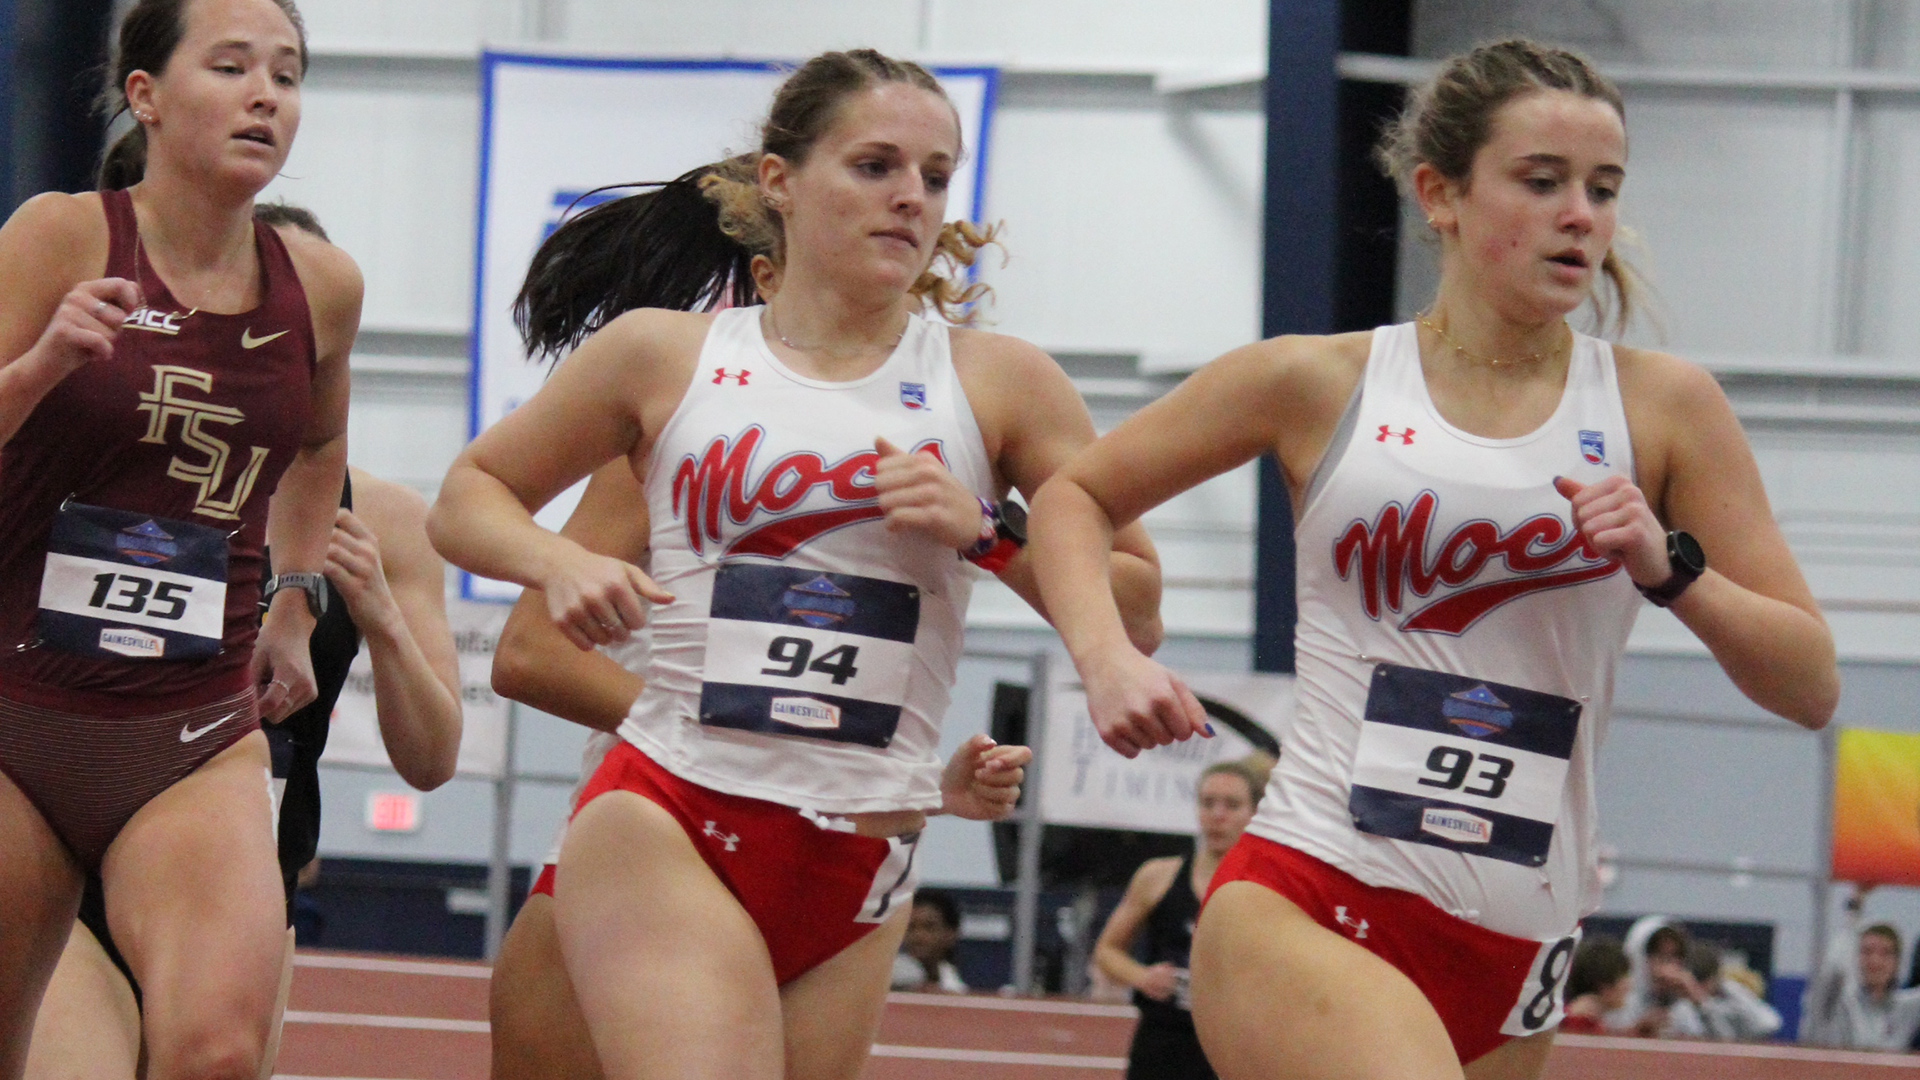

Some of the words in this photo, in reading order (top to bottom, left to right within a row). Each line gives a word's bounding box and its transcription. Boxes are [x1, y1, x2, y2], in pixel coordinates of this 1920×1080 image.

[123, 308, 181, 331] ACC
[137, 364, 270, 520] FSU
[672, 423, 950, 558] Moc
[89, 572, 193, 621] 135
[102, 633, 155, 650] GAINESVILLE
[761, 636, 859, 685] 94
[774, 702, 831, 720] GAINESVILLE
[1417, 745, 1515, 799] 93
[1425, 813, 1483, 835] GAINESVILLE
[1522, 936, 1575, 1030] 8
